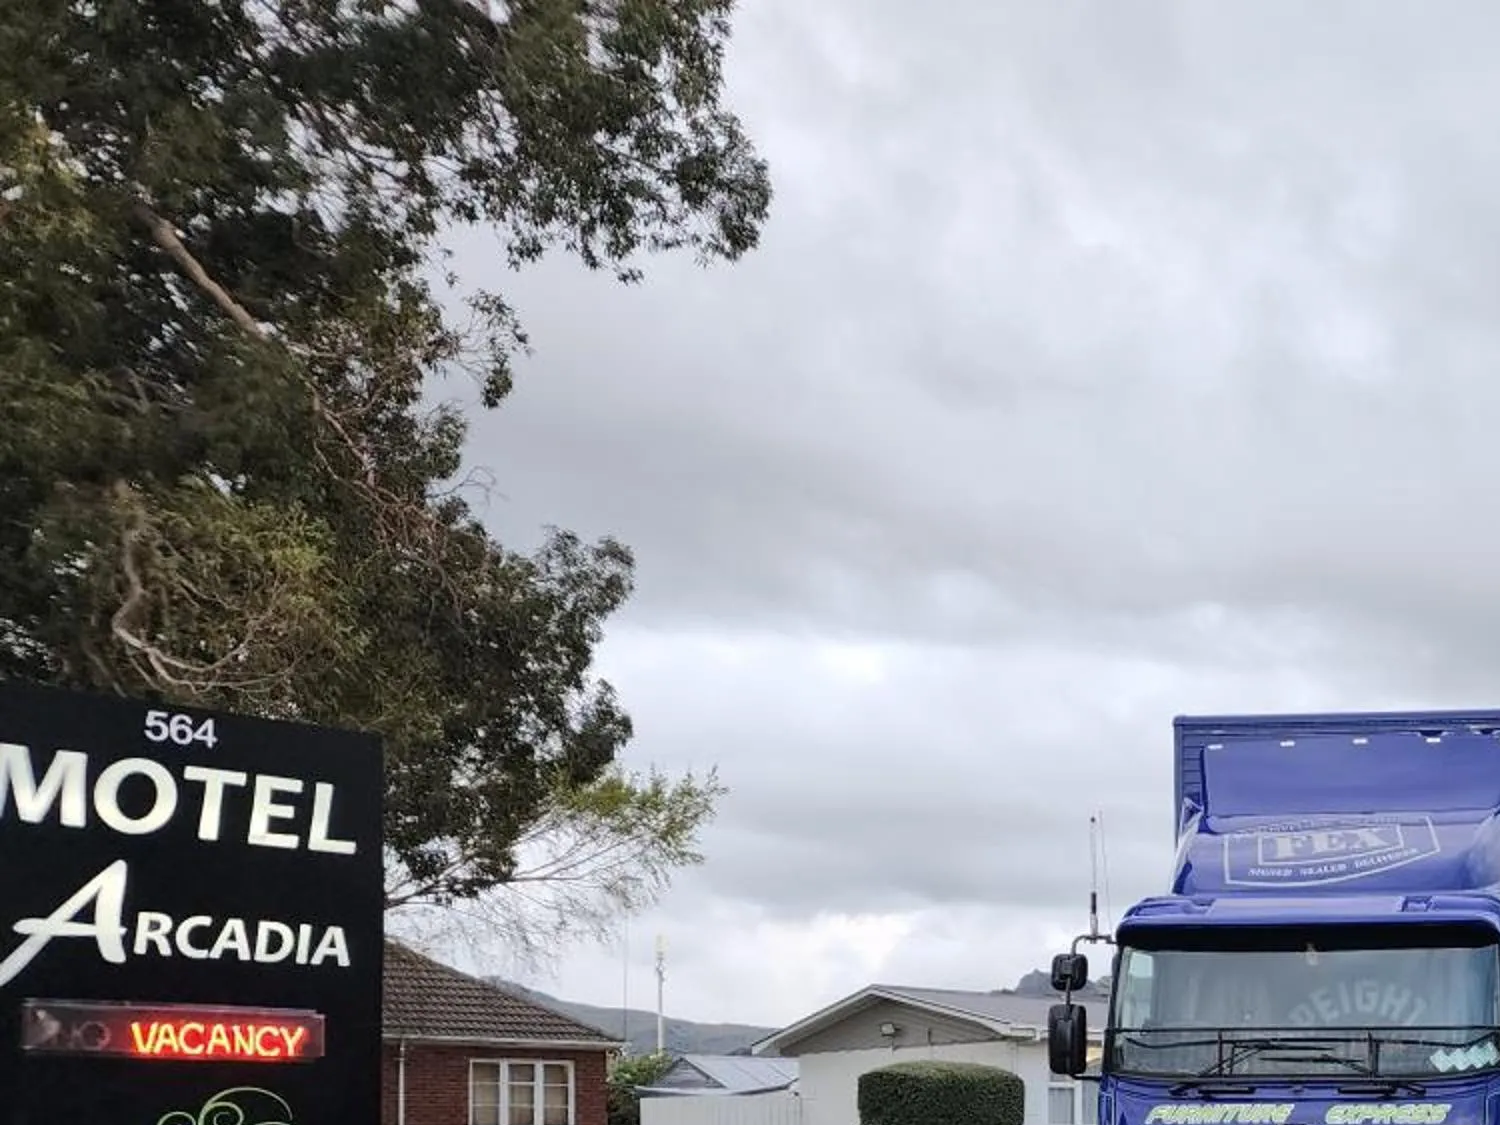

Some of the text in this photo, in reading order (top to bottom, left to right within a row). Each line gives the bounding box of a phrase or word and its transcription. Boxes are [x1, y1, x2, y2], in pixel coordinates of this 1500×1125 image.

[144, 709, 218, 748] 564
[0, 742, 357, 855] MOTEL
[1275, 827, 1391, 859] FEX
[0, 859, 351, 987] ARCADIA
[131, 1021, 305, 1057] VACANCY
[1145, 1103, 1452, 1125] FURNITURE EXPRESS
